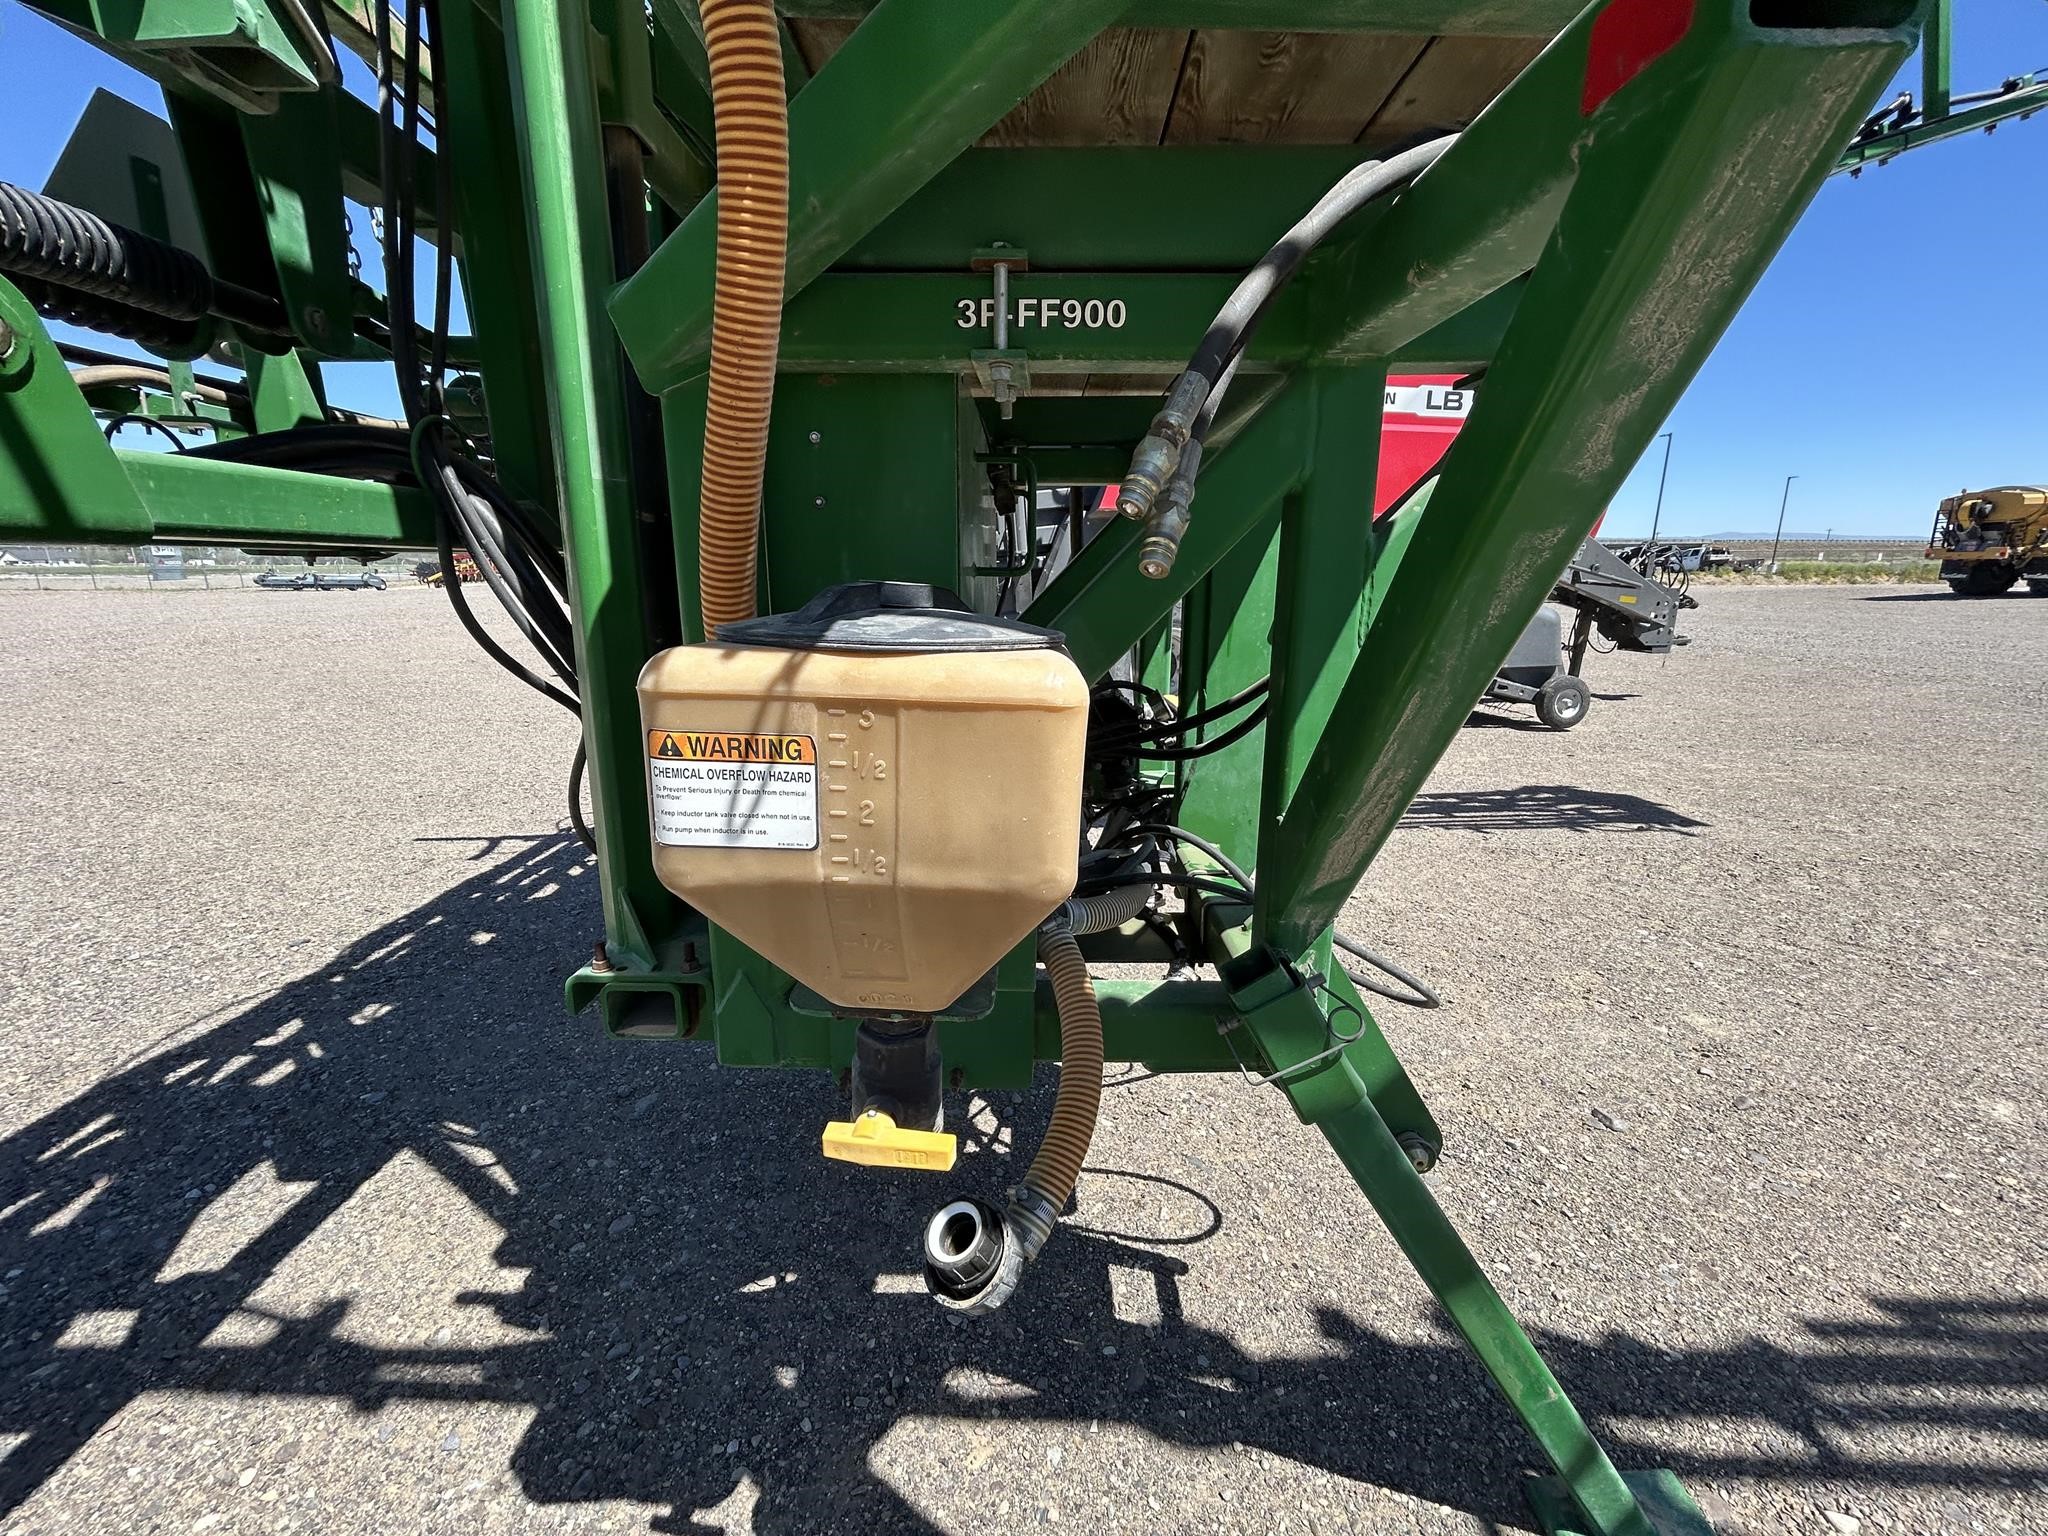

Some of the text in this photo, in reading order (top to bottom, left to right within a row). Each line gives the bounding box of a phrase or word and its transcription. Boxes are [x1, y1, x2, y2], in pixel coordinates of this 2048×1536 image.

[687, 735, 802, 761] WARNING
[653, 766, 812, 783] CHEMICAL OVERFLOW HAZARD
[714, 787, 732, 795] Injury
[660, 809, 675, 817] Keep
[859, 799, 875, 826] 2
